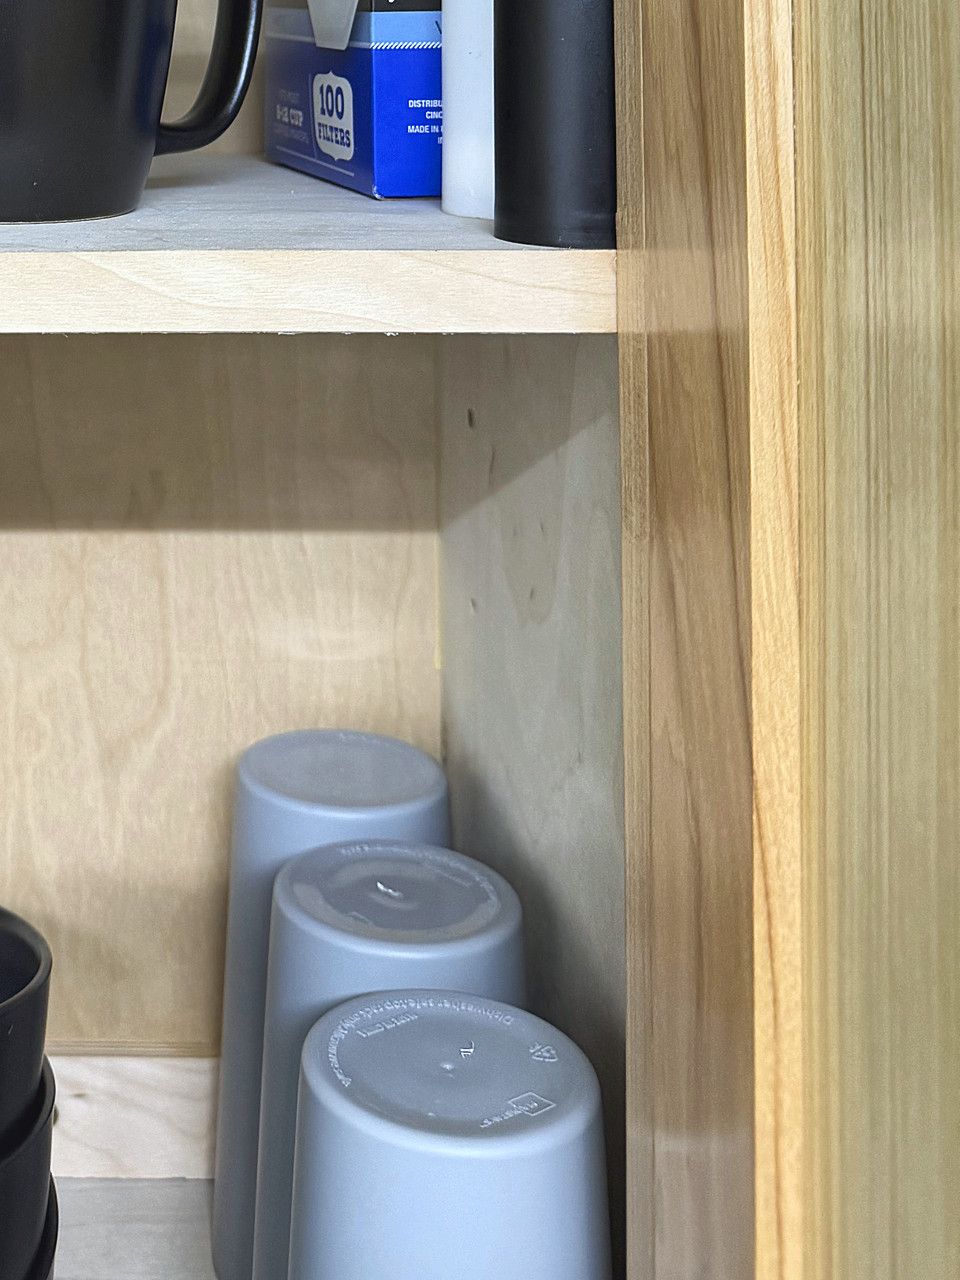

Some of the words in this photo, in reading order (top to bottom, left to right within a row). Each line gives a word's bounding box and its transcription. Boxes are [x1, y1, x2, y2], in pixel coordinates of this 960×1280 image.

[319, 84, 344, 120] 100
[318, 123, 351, 148] FILTERS
[407, 125, 430, 133] MADE
